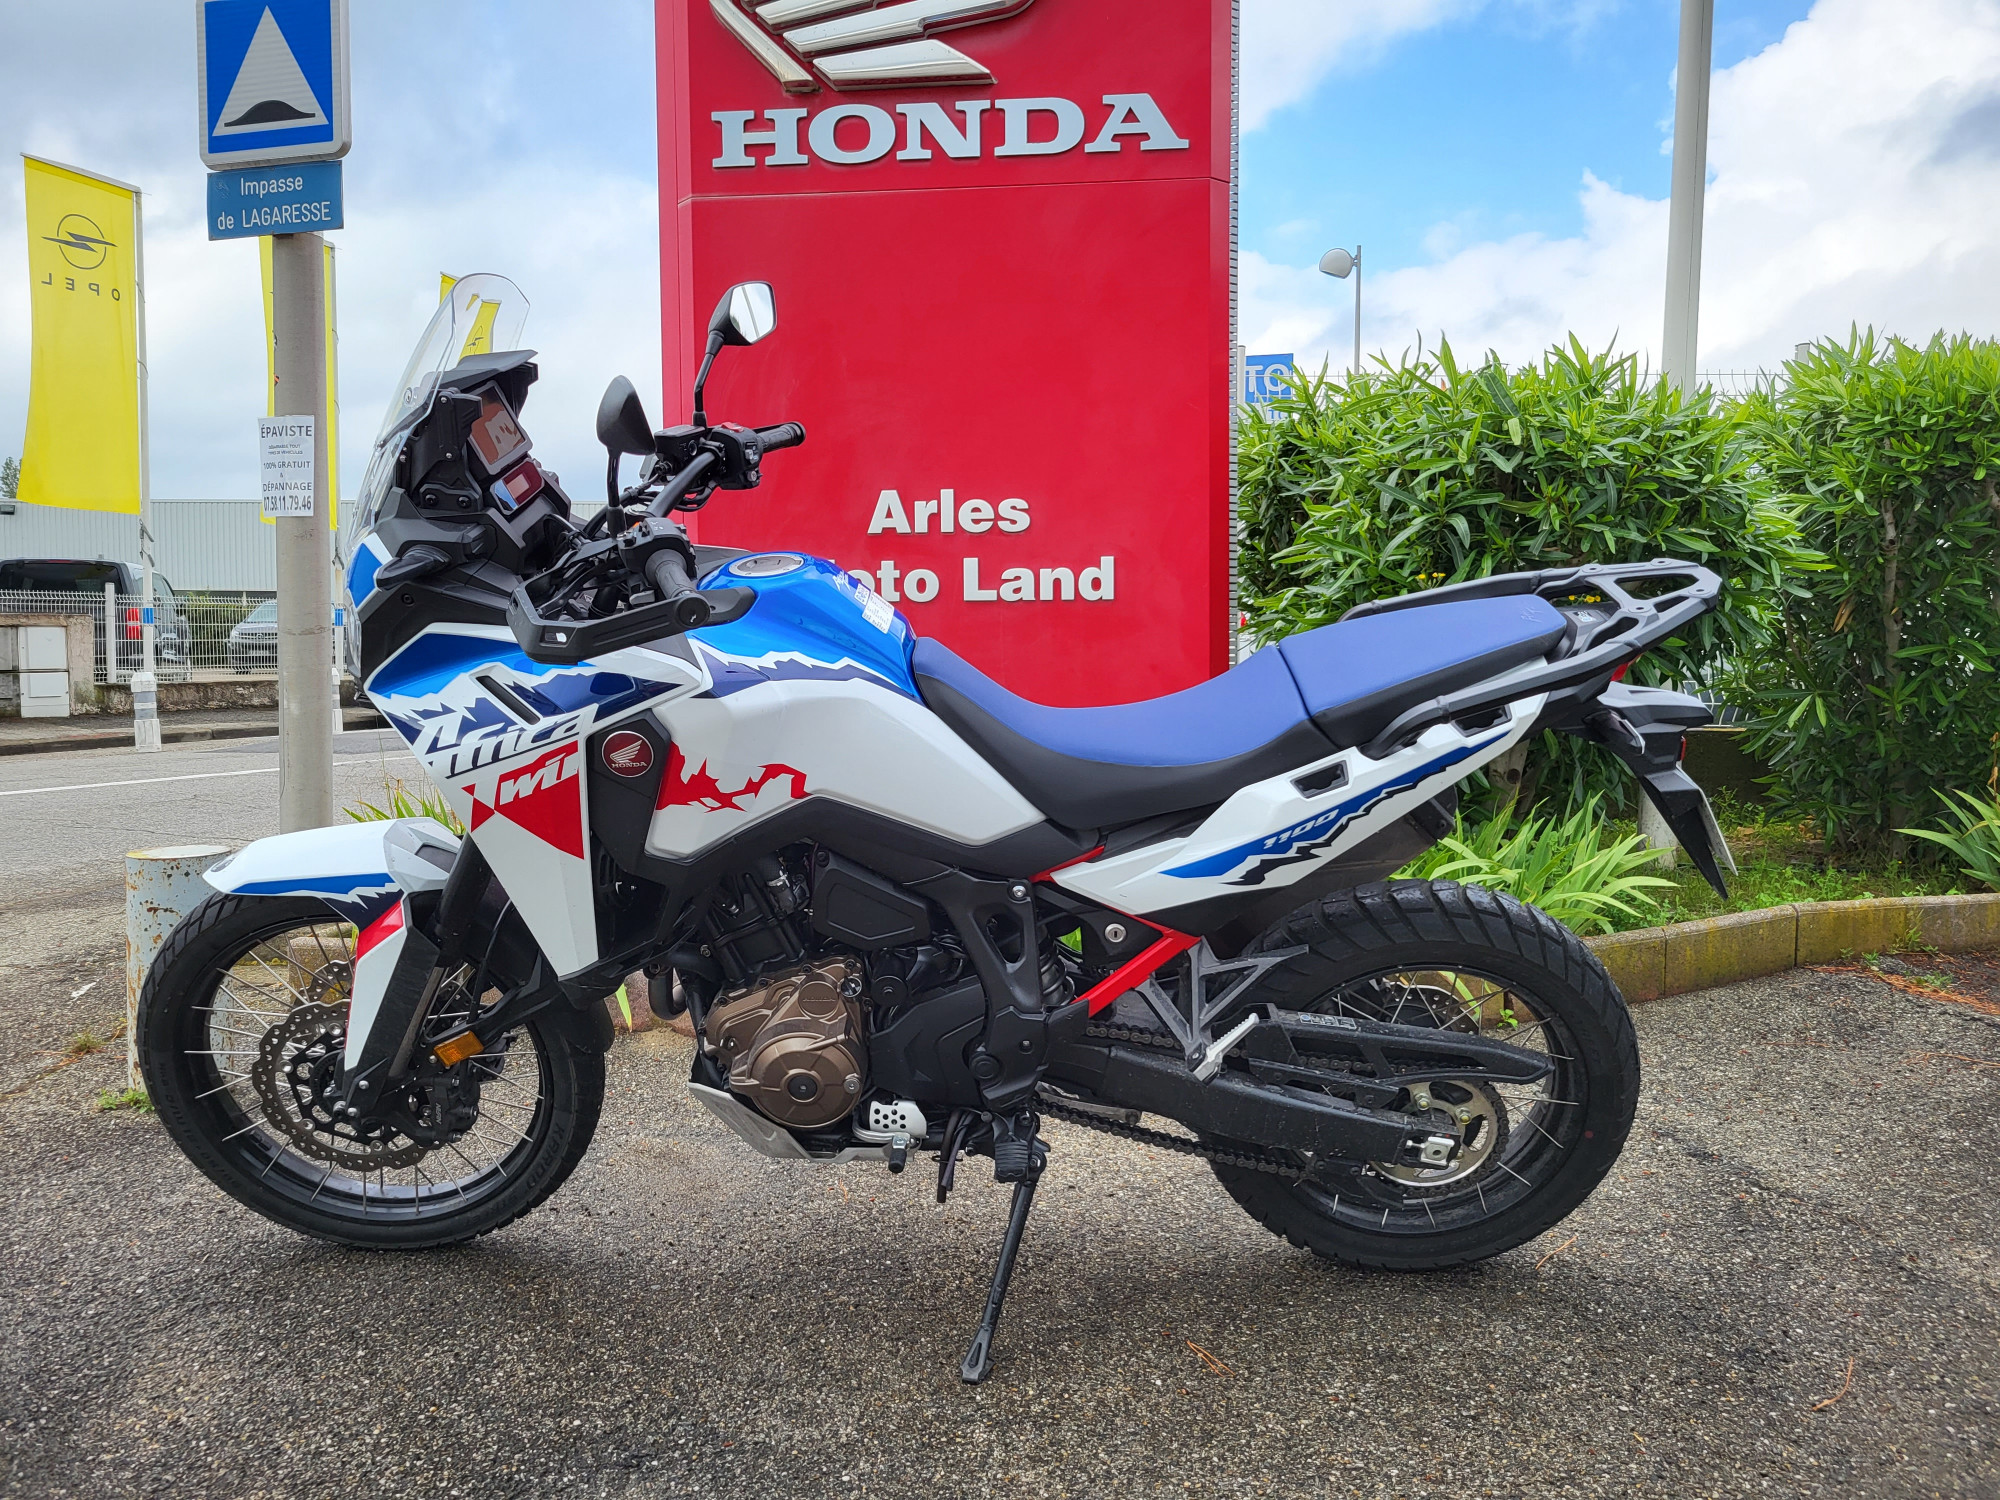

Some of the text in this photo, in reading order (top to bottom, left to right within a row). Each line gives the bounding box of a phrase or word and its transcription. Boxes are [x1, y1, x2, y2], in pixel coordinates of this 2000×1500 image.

[711, 93, 1189, 168] HONDA
[240, 176, 303, 199] Impasse
[217, 201, 331, 230] de LAGARESSE
[261, 424, 313, 438] ÉPAVISTE
[263, 461, 311, 470] 100% GRATUIT
[263, 481, 313, 492] DÉPANNAGE
[867, 488, 1031, 534] Arles
[963, 556, 1115, 602] Land
[412, 712, 581, 776] Africa
[611, 761, 648, 769] HONDA
[1263, 808, 1340, 850] 1100
